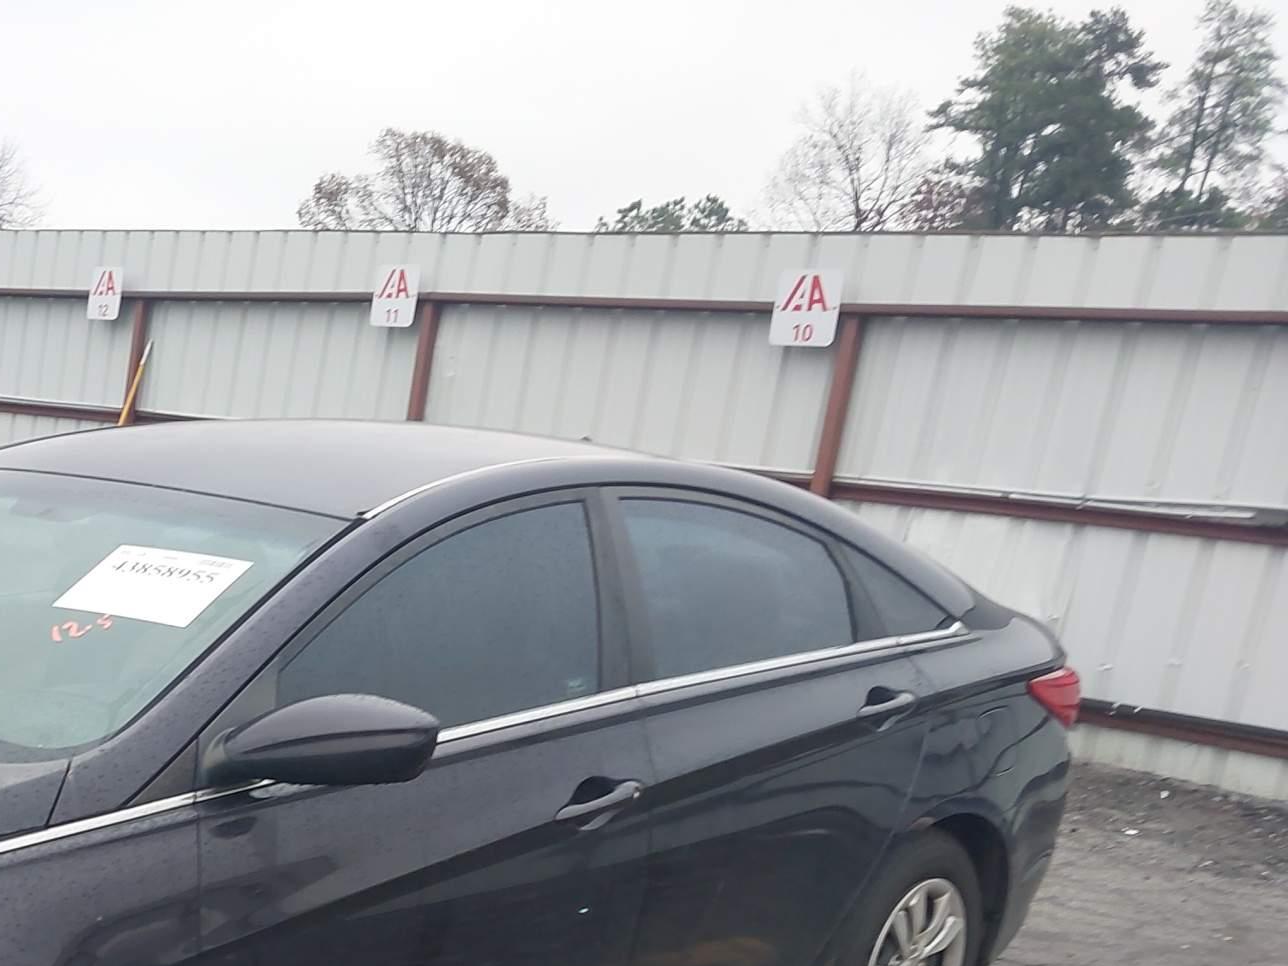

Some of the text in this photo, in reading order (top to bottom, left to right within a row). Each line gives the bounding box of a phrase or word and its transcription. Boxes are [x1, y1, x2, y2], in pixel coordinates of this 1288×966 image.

[385, 308, 399, 323] 11
[792, 323, 814, 343] 10
[112, 560, 220, 585] 43858955
